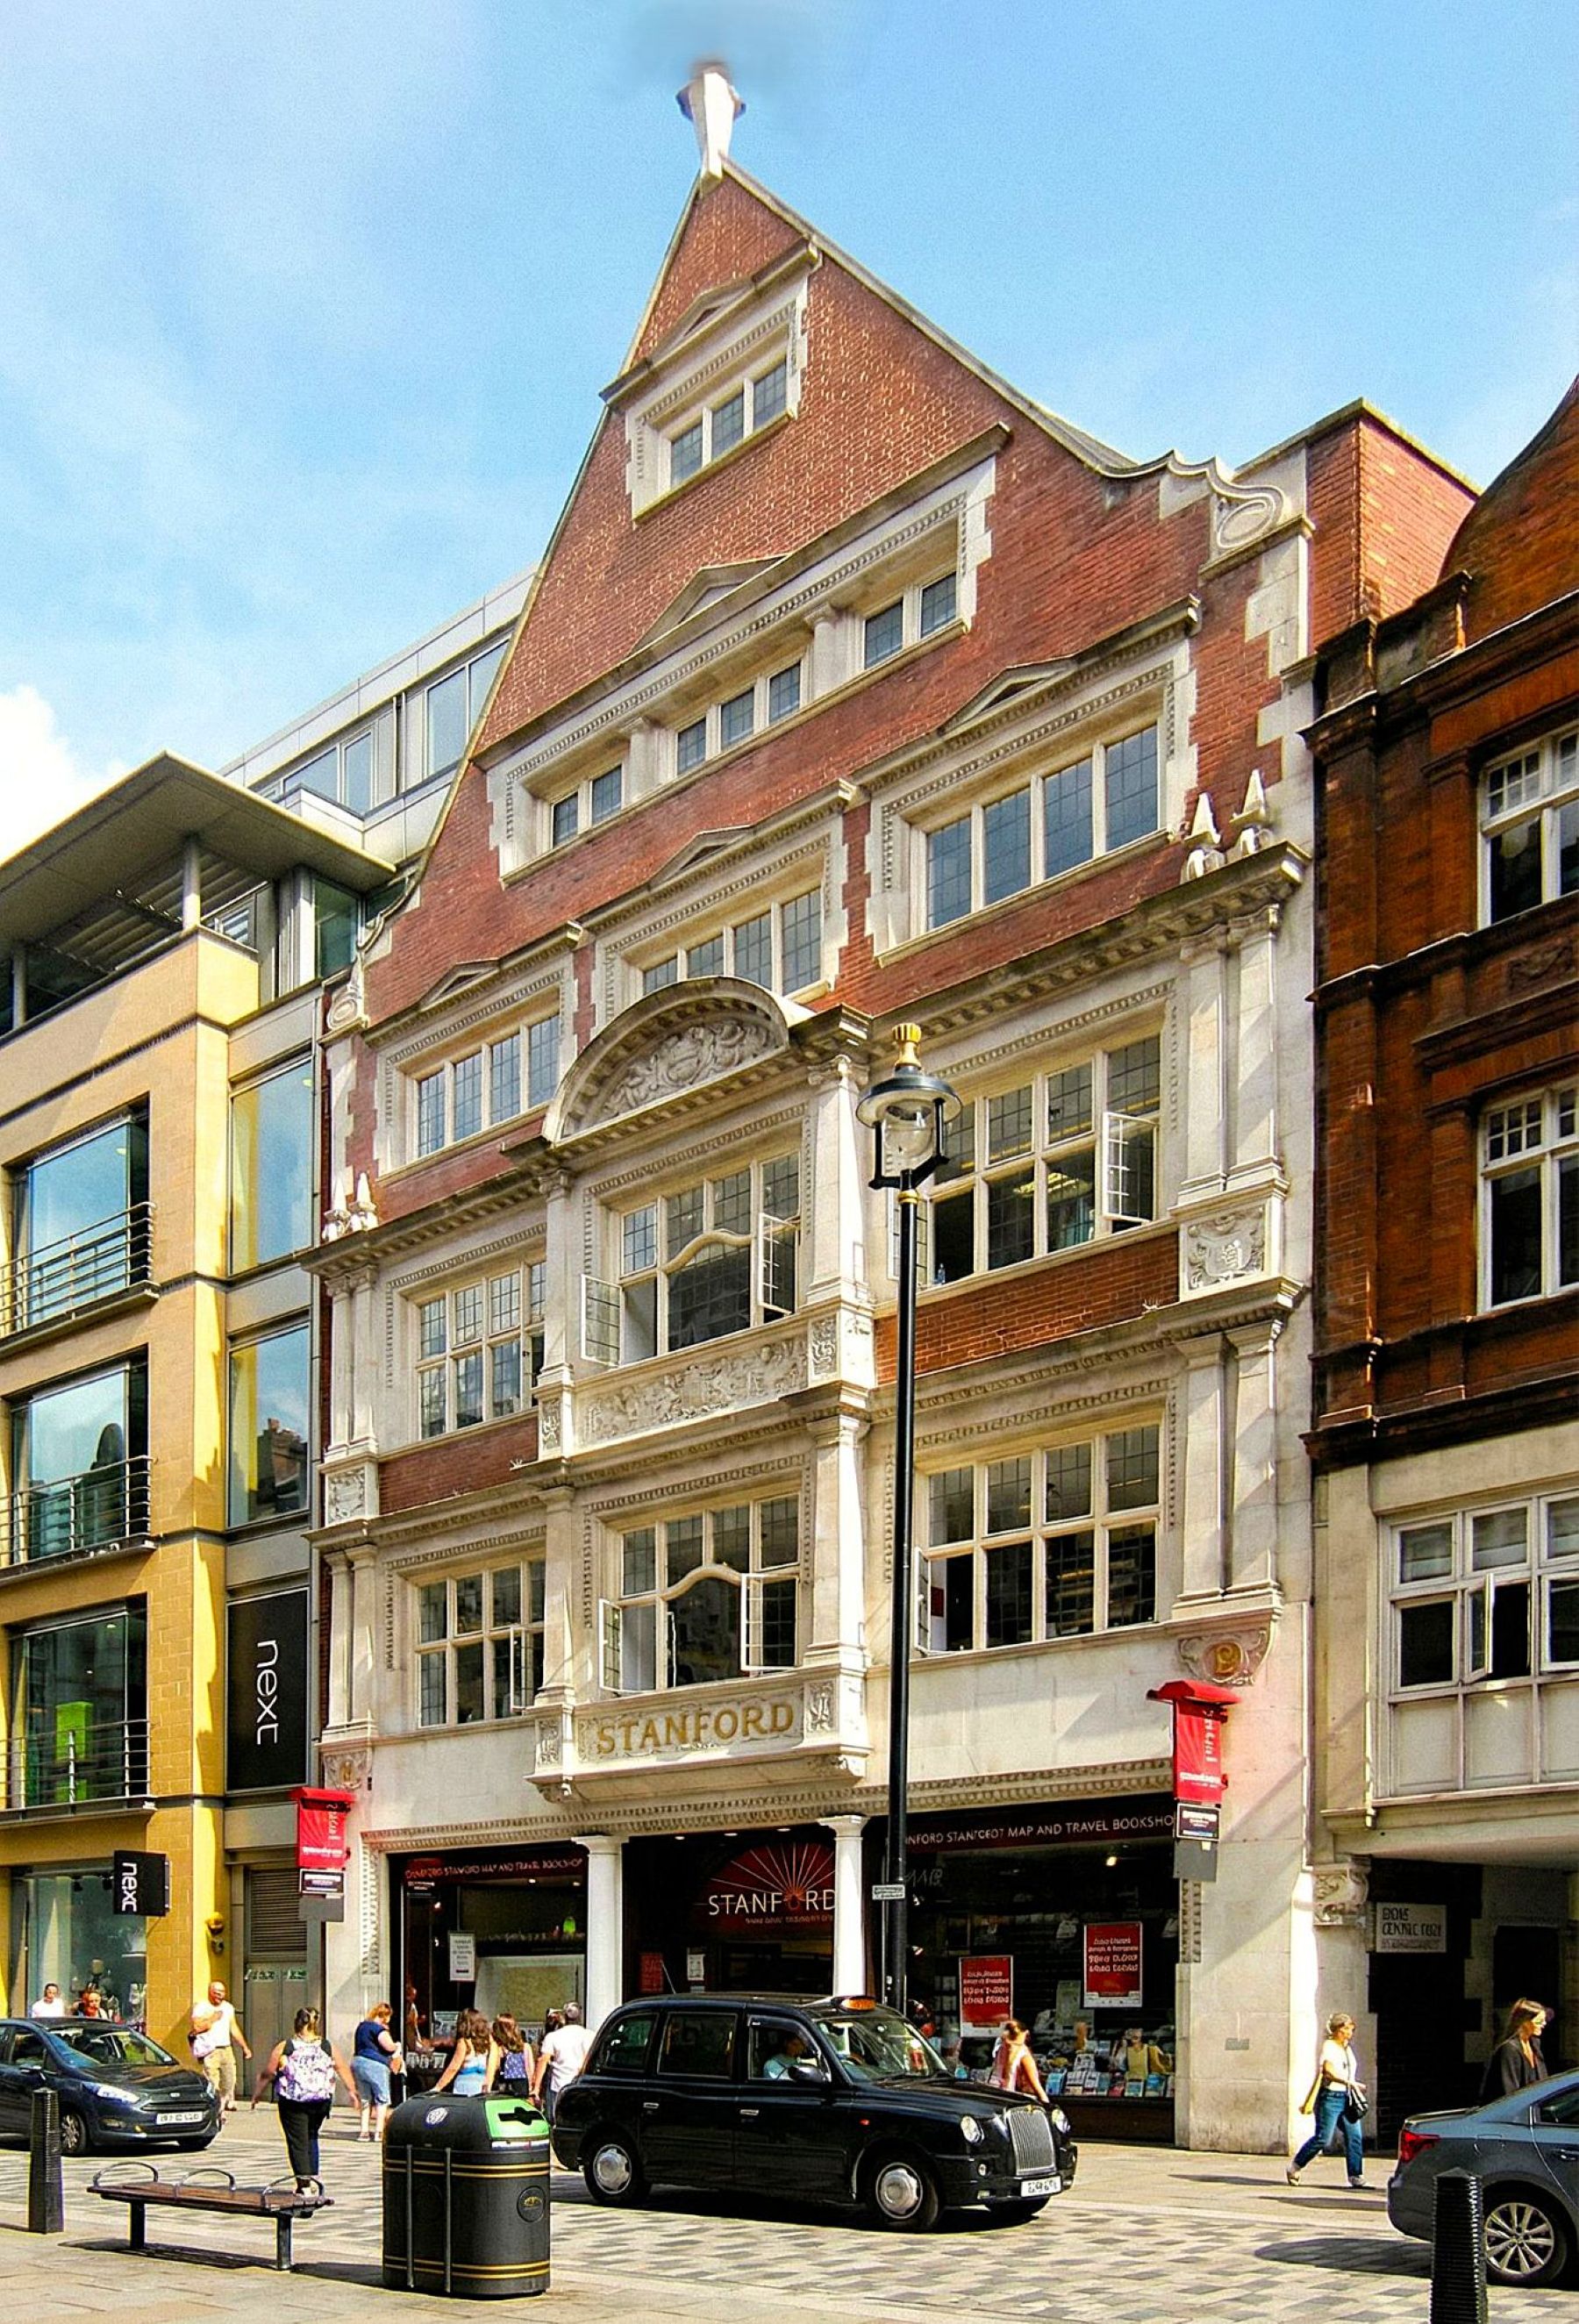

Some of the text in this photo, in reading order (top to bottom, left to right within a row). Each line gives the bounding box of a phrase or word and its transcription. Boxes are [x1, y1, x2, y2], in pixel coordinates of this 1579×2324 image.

[256, 1640, 279, 1745] next
[597, 1701, 794, 1755] STANFORD
[1008, 1826, 1034, 1838] MAP
[1037, 1823, 1062, 1835] AND
[1065, 1820, 1109, 1834] TRAVEL
[1112, 1814, 1175, 1830] BOOKSHO
[122, 1862, 138, 1912] next
